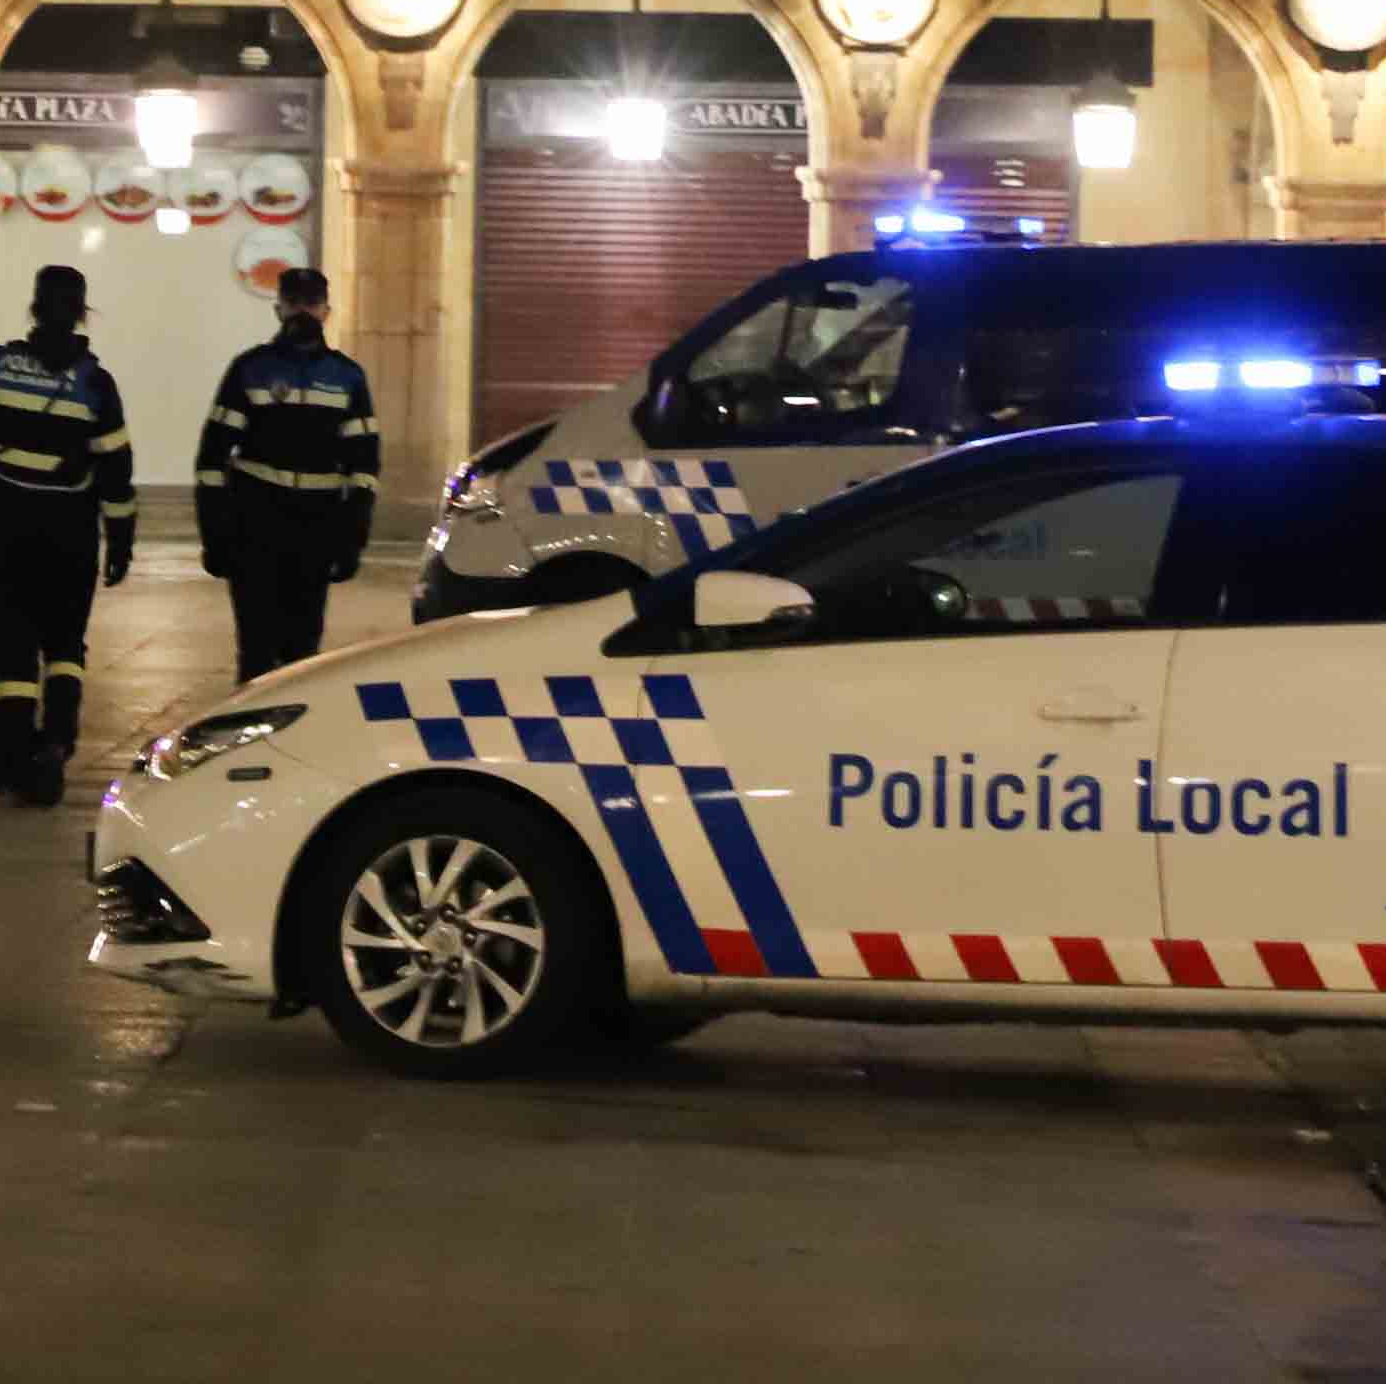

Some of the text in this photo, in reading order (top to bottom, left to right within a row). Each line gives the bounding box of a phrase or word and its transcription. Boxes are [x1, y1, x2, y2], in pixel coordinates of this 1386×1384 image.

[36, 96, 115, 121] PLAZA
[827, 753, 1348, 838] Policía Local
